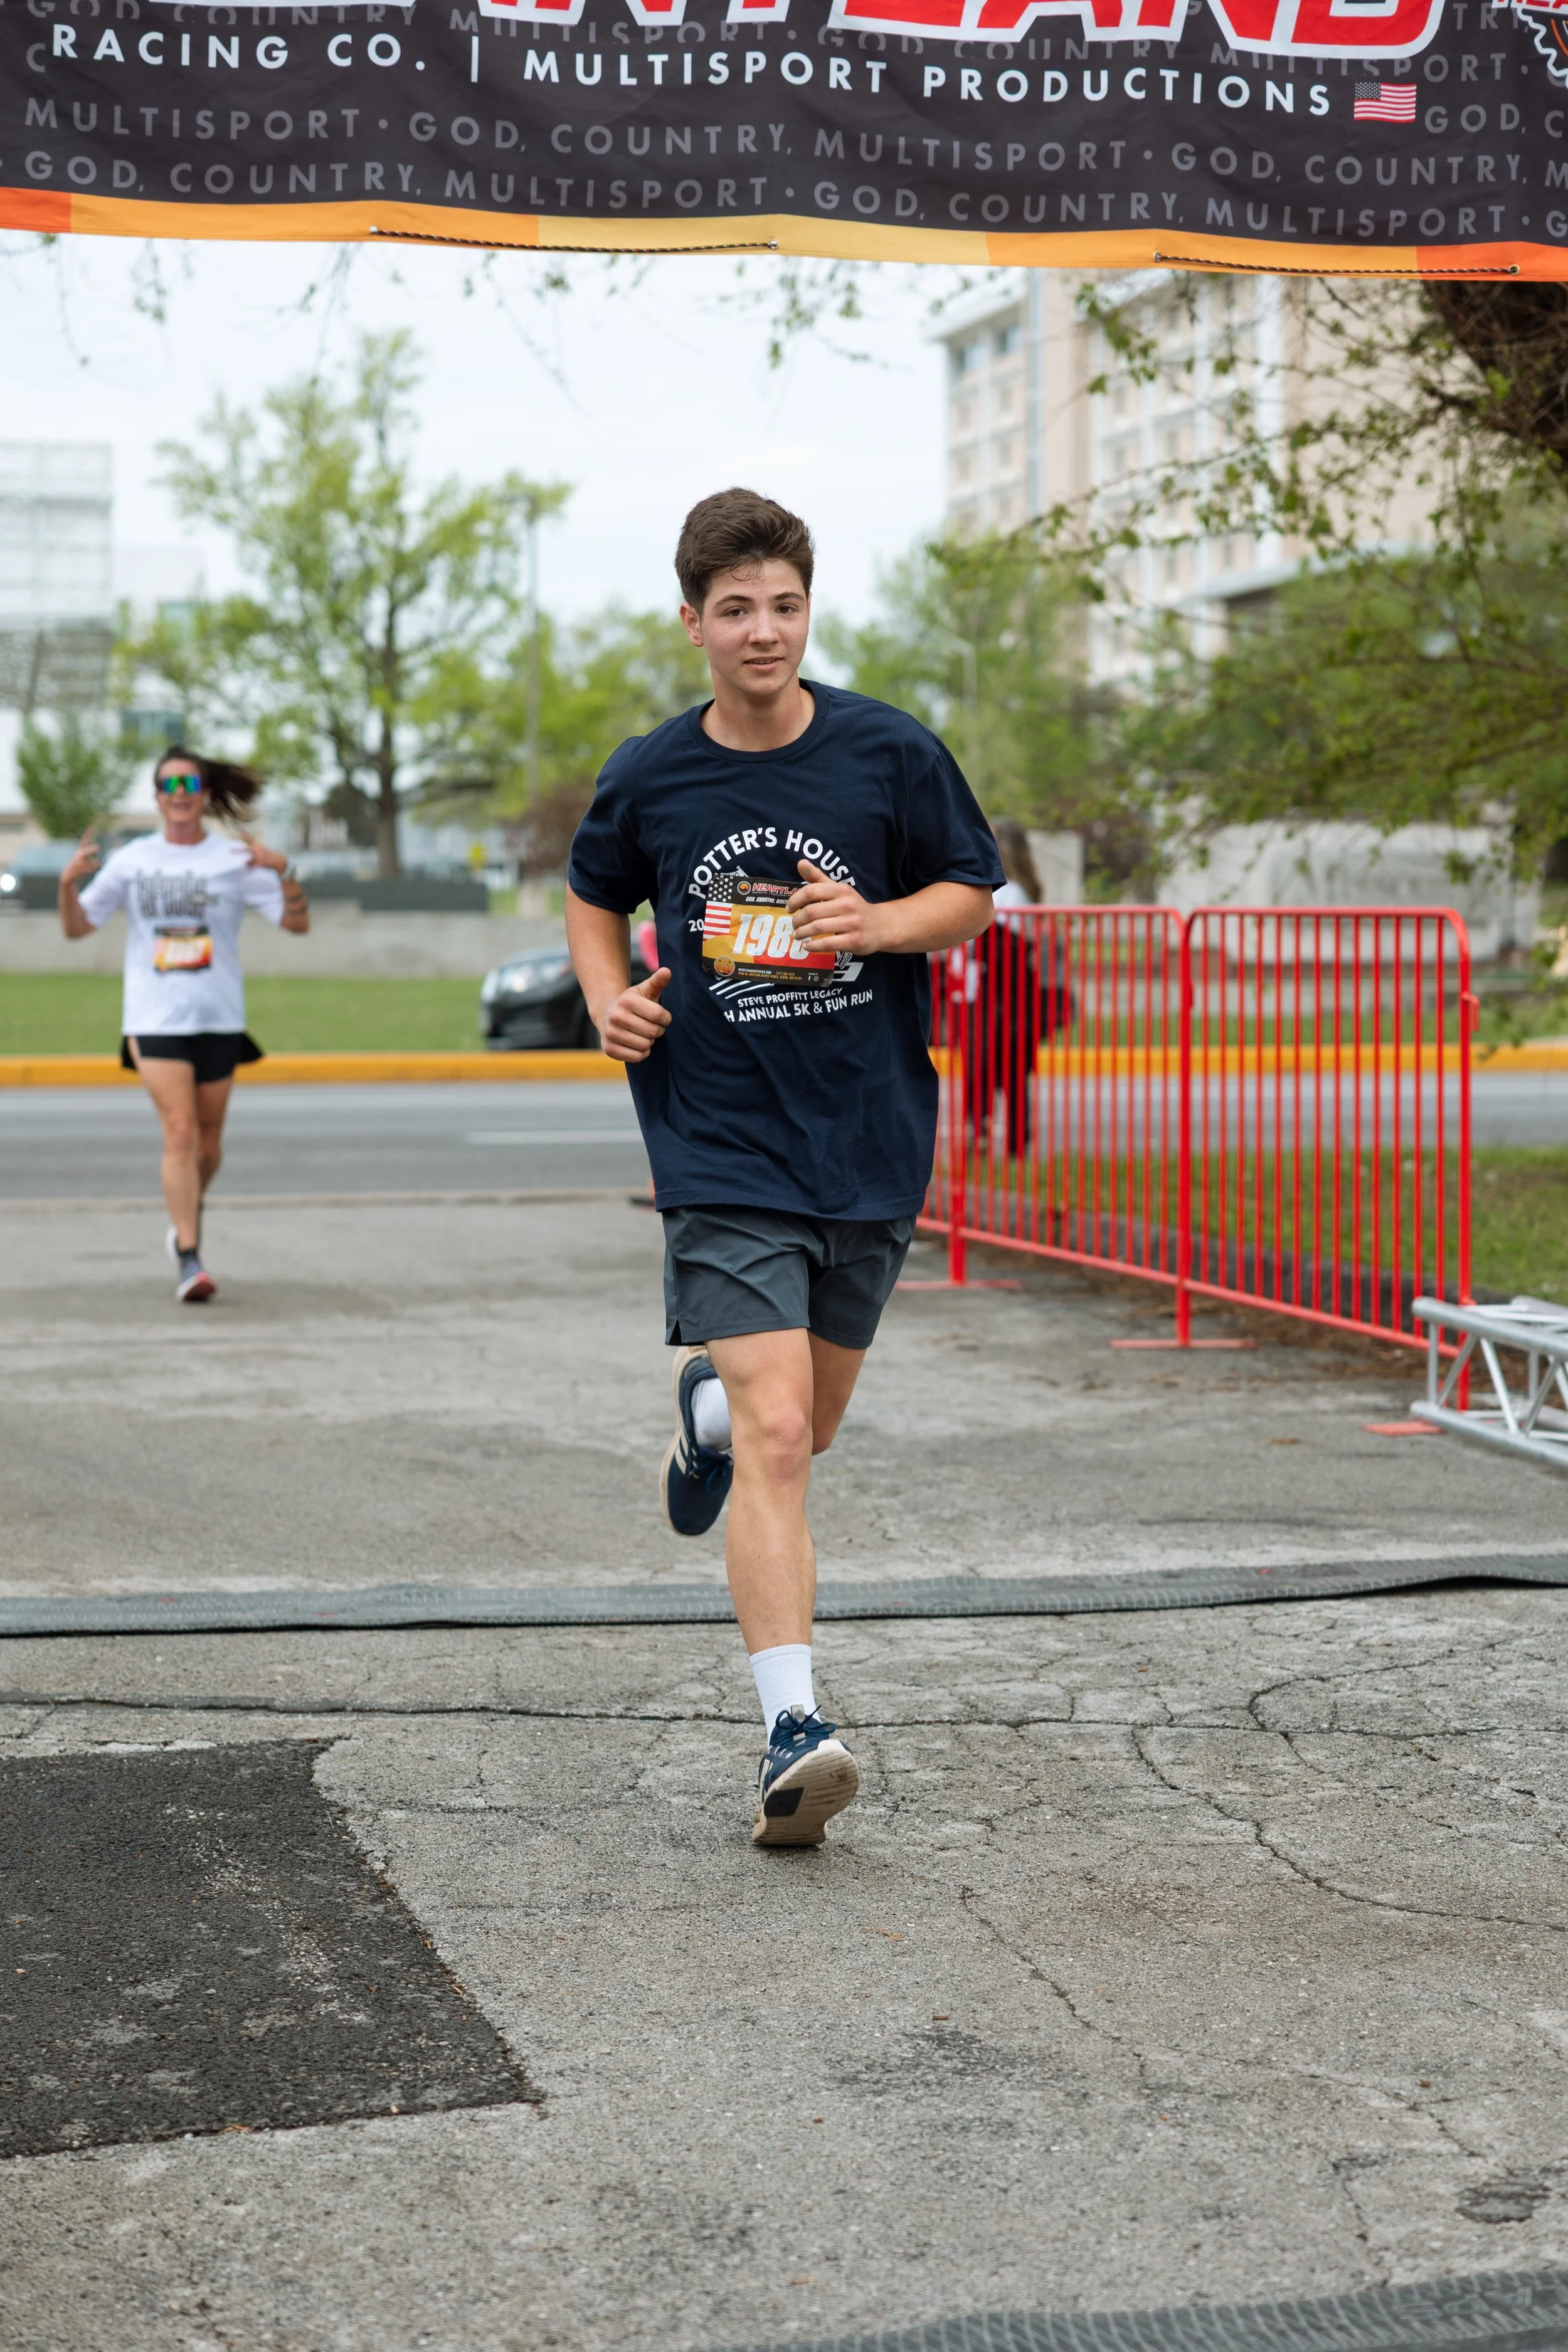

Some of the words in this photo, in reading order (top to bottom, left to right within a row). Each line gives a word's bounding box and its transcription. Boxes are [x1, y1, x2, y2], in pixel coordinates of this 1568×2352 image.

[53, 24, 288, 69] RACING
[327, 33, 425, 70] CO.
[524, 50, 886, 93] MULTISPORT
[923, 66, 1330, 115] PRODUCTIONS
[24, 97, 360, 141] MULTISPORT
[408, 111, 526, 153] GOD,
[550, 123, 792, 156] COUNTRY,
[813, 128, 1126, 172] MULTISPORT
[1171, 142, 1281, 183] GOD,
[1304, 154, 1527, 186] COUNTRY,
[1424, 103, 1526, 135] GOD,
[24, 150, 144, 193] GOD,
[169, 161, 421, 196] COUNTRY,
[444, 169, 768, 209] MULTISPORT
[813, 181, 925, 220] GOD,
[948, 191, 1184, 224] COUNTRY,
[1205, 197, 1506, 237] MULTISPORT
[688, 827, 778, 899] POTTER'S
[752, 883, 799, 895] HEARTLA
[723, 1009, 735, 1022] H
[738, 1005, 792, 1022] ANNUAL
[793, 1003, 811, 1016] 5K
[813, 1002, 823, 1014] &
[825, 996, 847, 1013] FUN
[850, 988, 872, 1006] RUN
[738, 996, 765, 1007] STEVE
[765, 992, 808, 1004] PROFFITT
[810, 987, 843, 999] LEGACY
